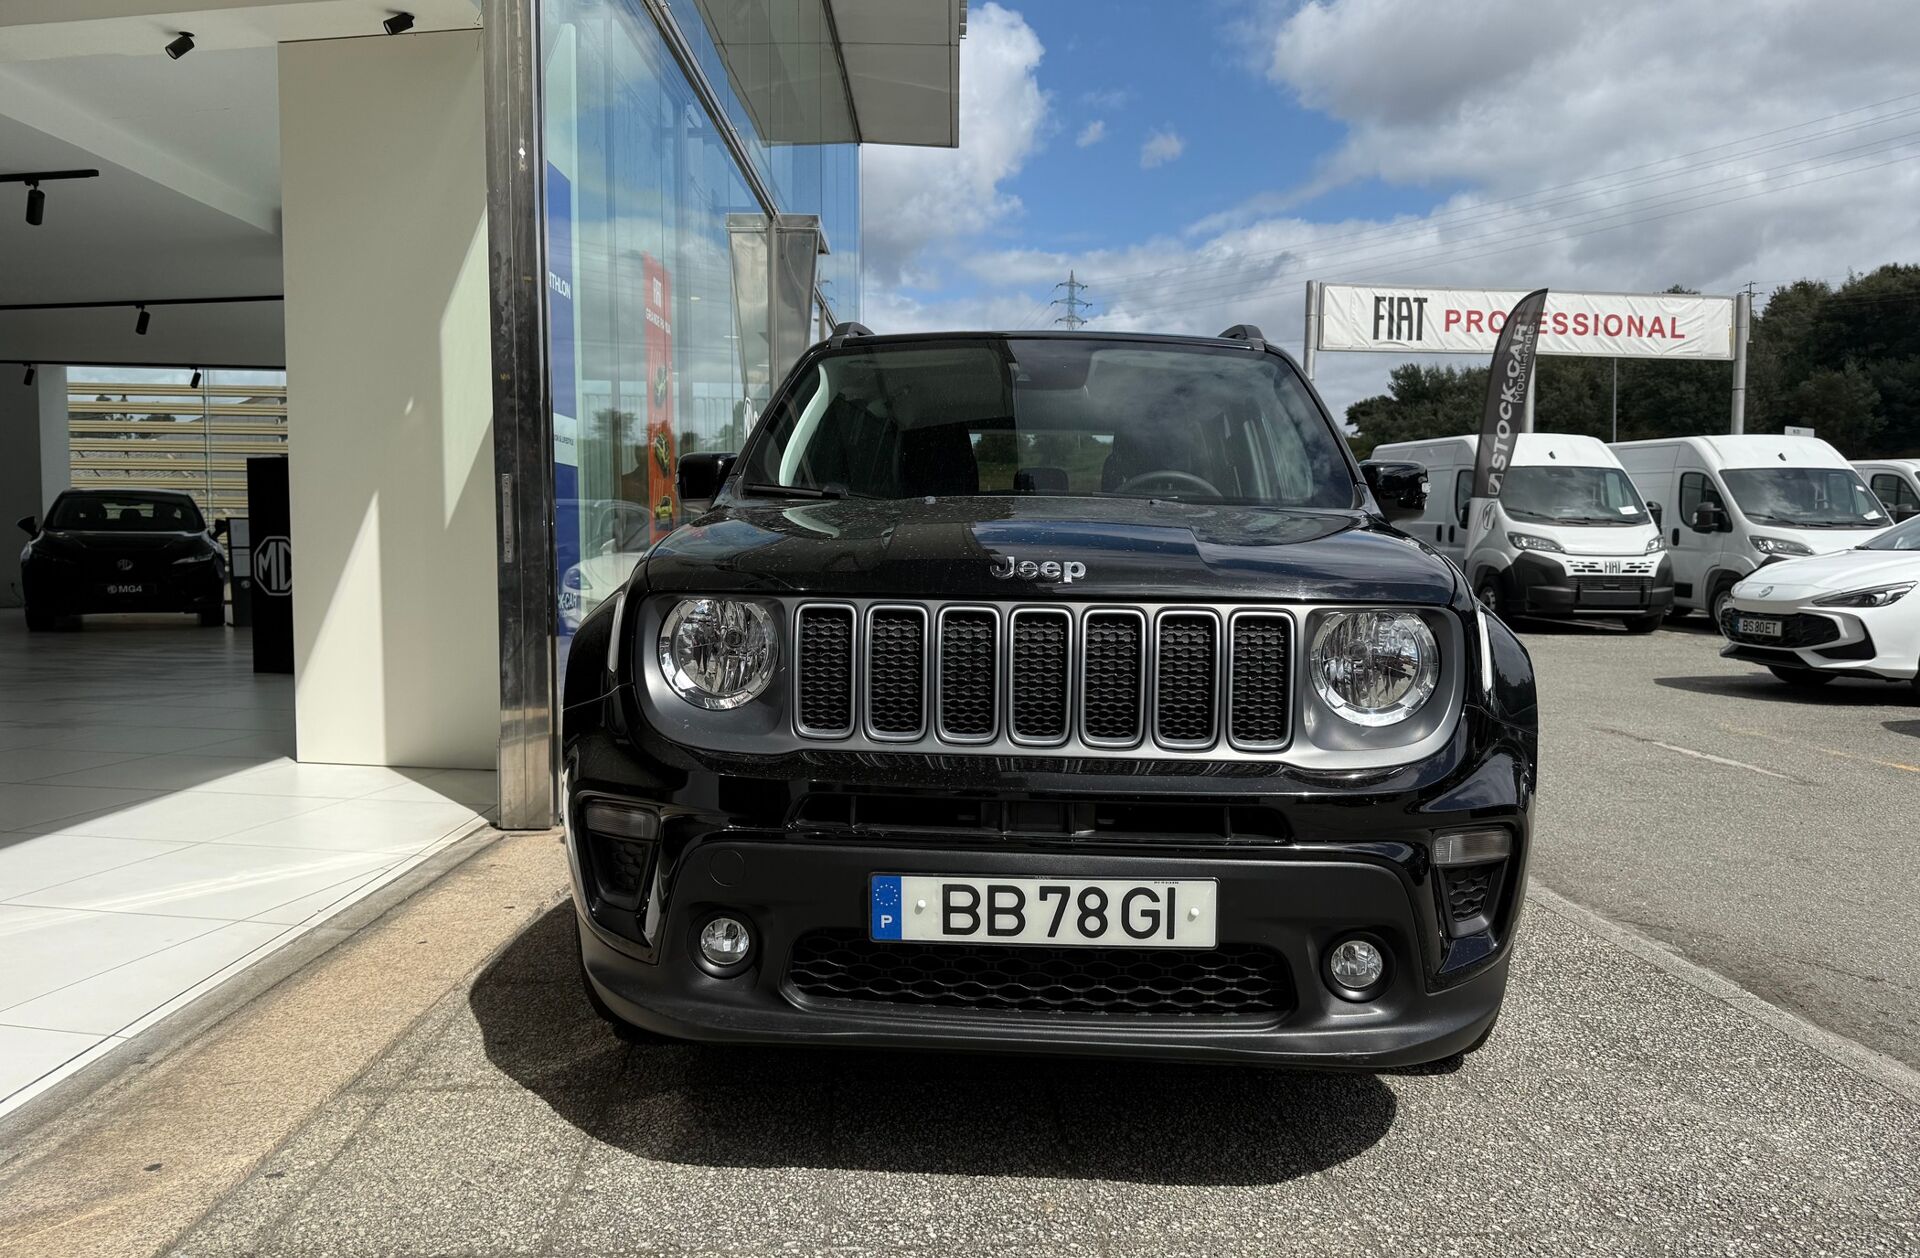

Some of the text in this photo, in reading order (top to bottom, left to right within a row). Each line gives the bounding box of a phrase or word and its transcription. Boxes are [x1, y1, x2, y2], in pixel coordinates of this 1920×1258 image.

[1373, 296, 1686, 341] FIAT PROESSIONAL
[990, 556, 1086, 583] Jeep
[881, 915, 893, 929] P
